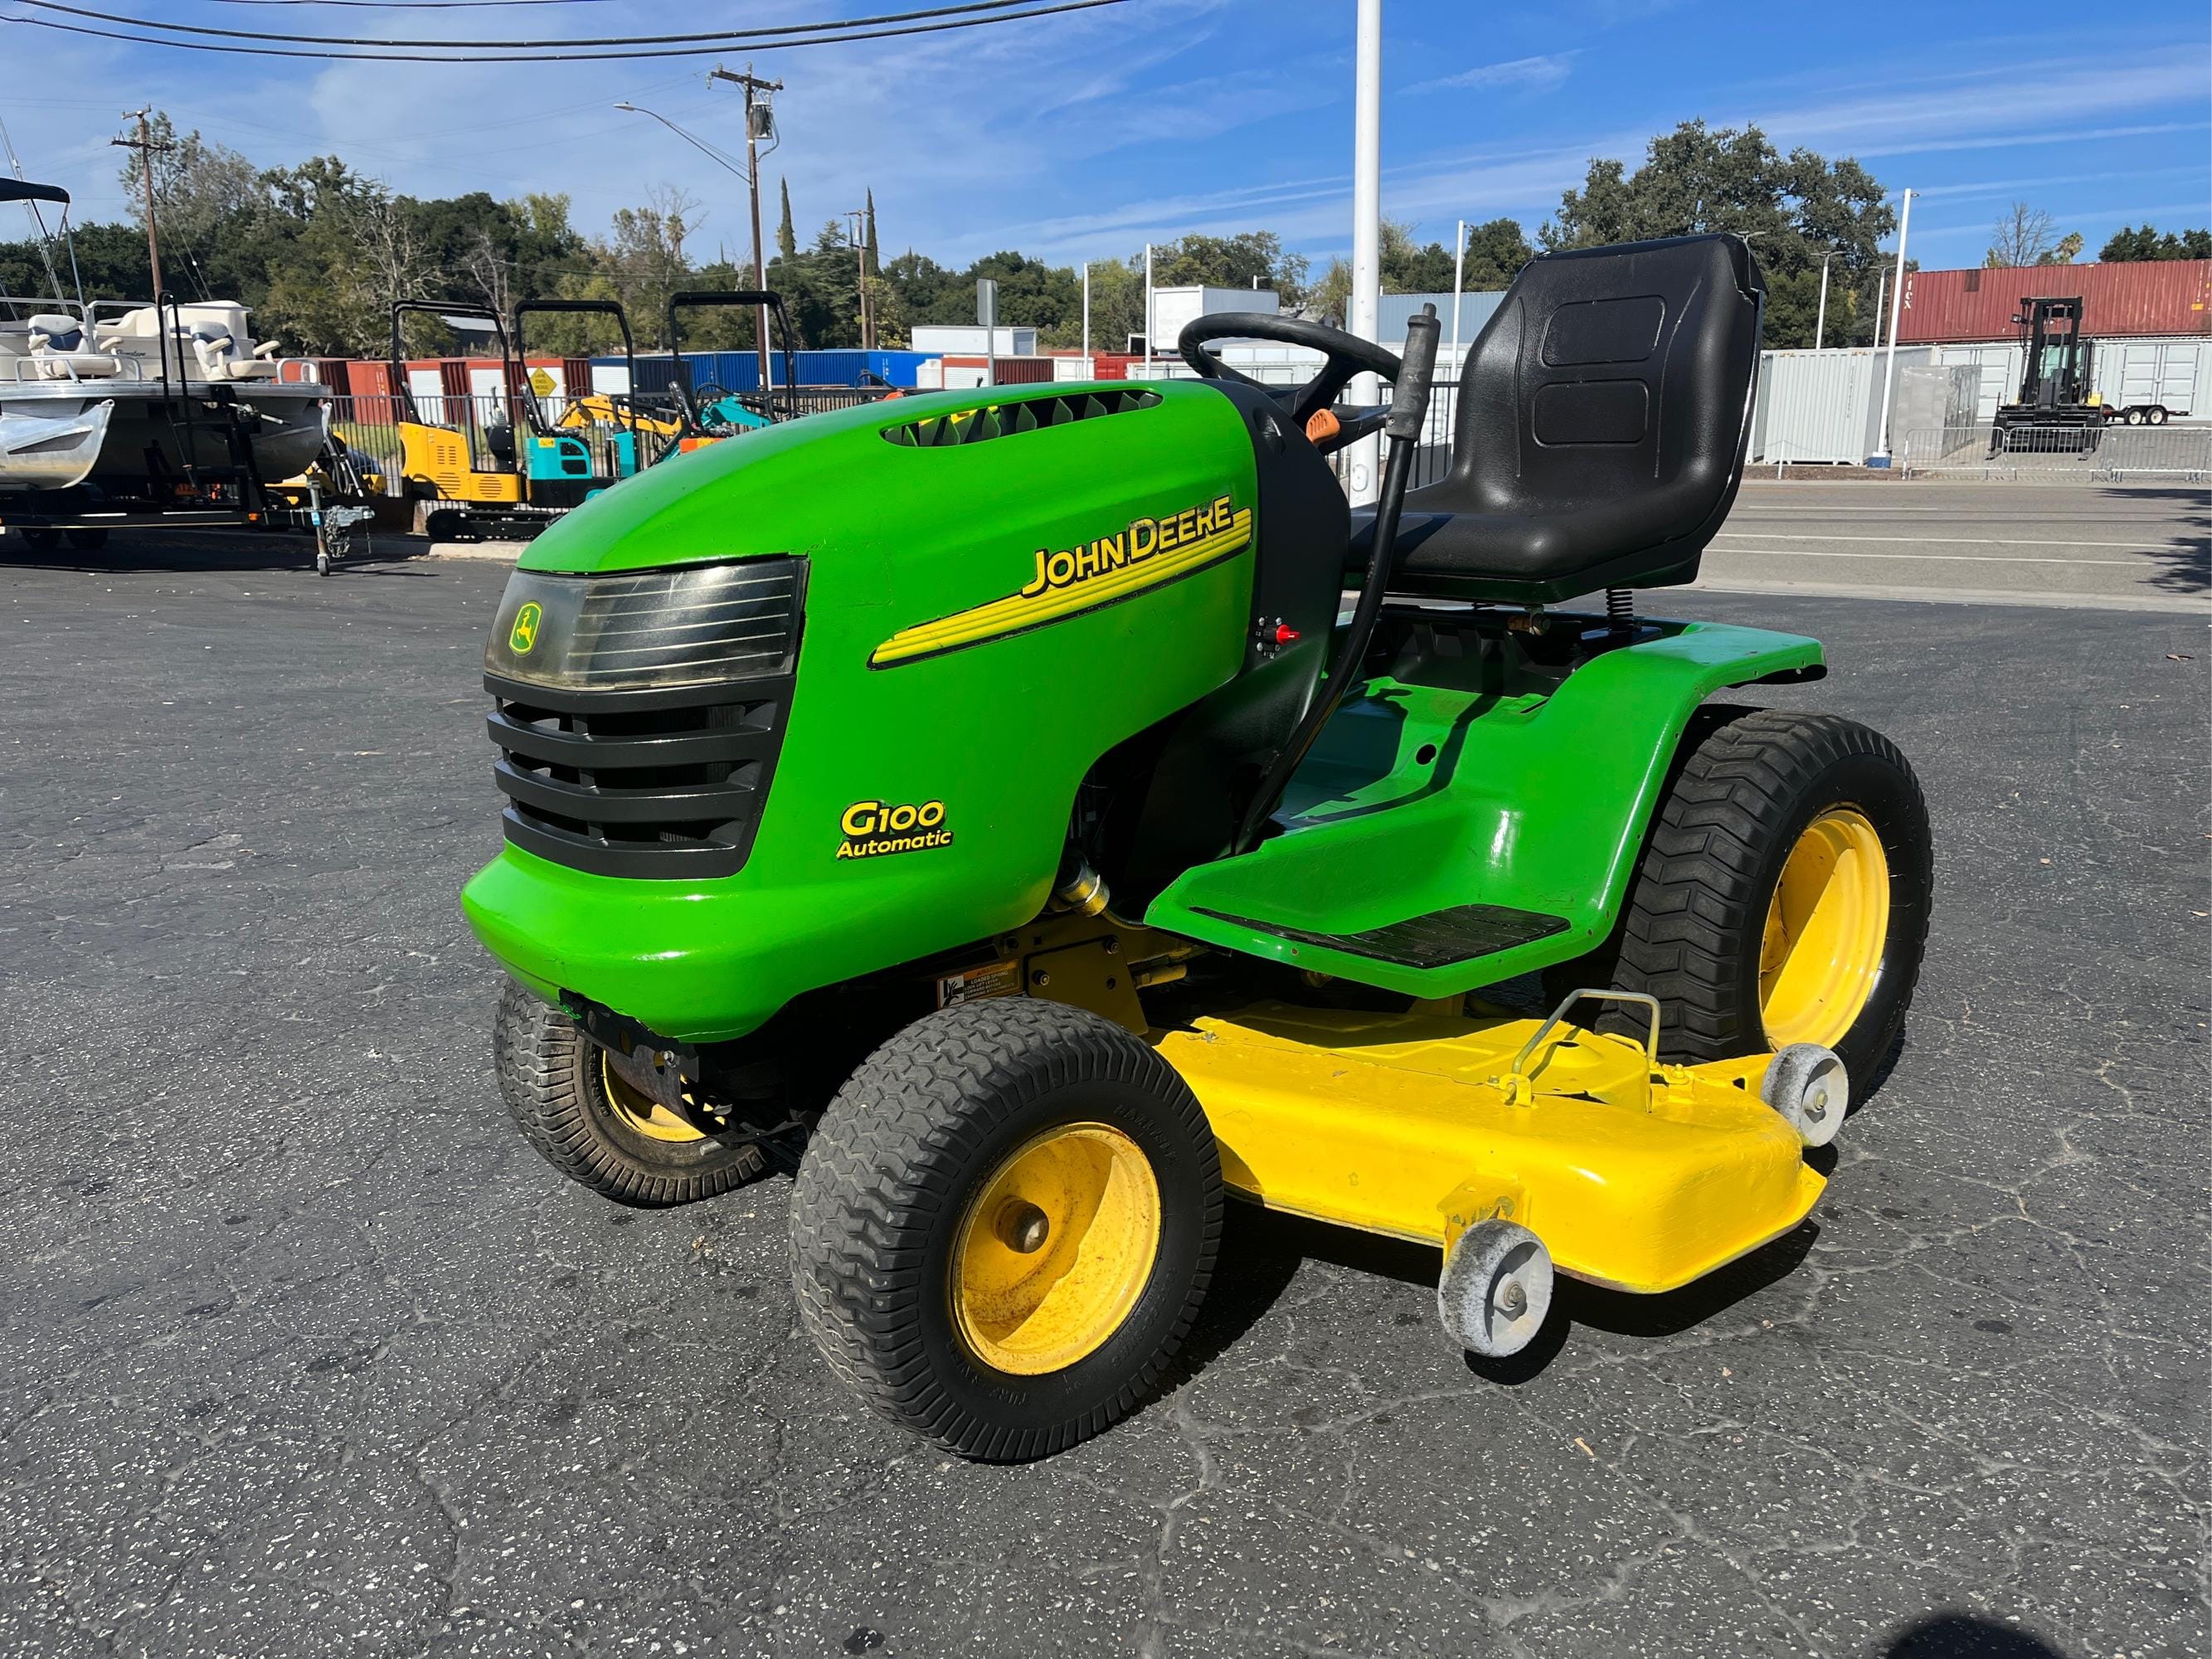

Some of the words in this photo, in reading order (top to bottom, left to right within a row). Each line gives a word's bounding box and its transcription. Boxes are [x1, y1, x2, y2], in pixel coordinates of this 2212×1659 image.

[1022, 532, 1125, 596] JOHN
[1129, 494, 1232, 562] DEERE
[841, 801, 945, 836] G100
[836, 830, 951, 859] Automatic
[970, 975, 990, 985] LOADED
